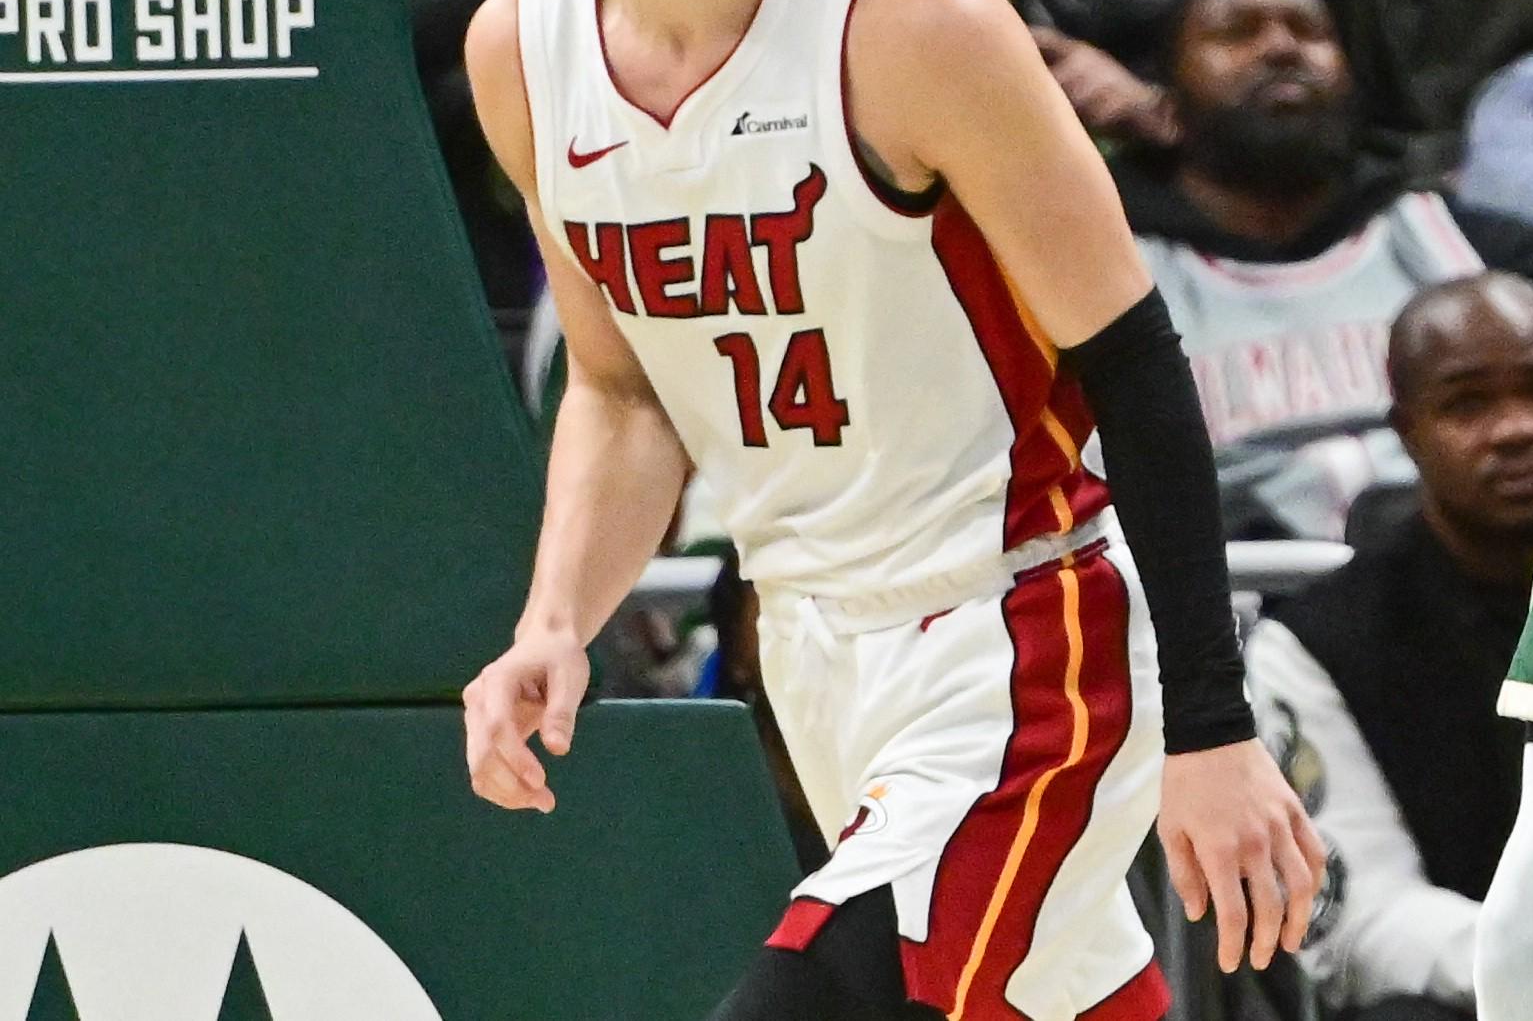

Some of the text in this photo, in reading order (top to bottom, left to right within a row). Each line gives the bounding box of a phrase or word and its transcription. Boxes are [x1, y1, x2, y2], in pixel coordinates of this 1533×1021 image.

[746, 113, 808, 133] Carnival
[563, 162, 828, 318] HEAT
[713, 328, 851, 448] 14
